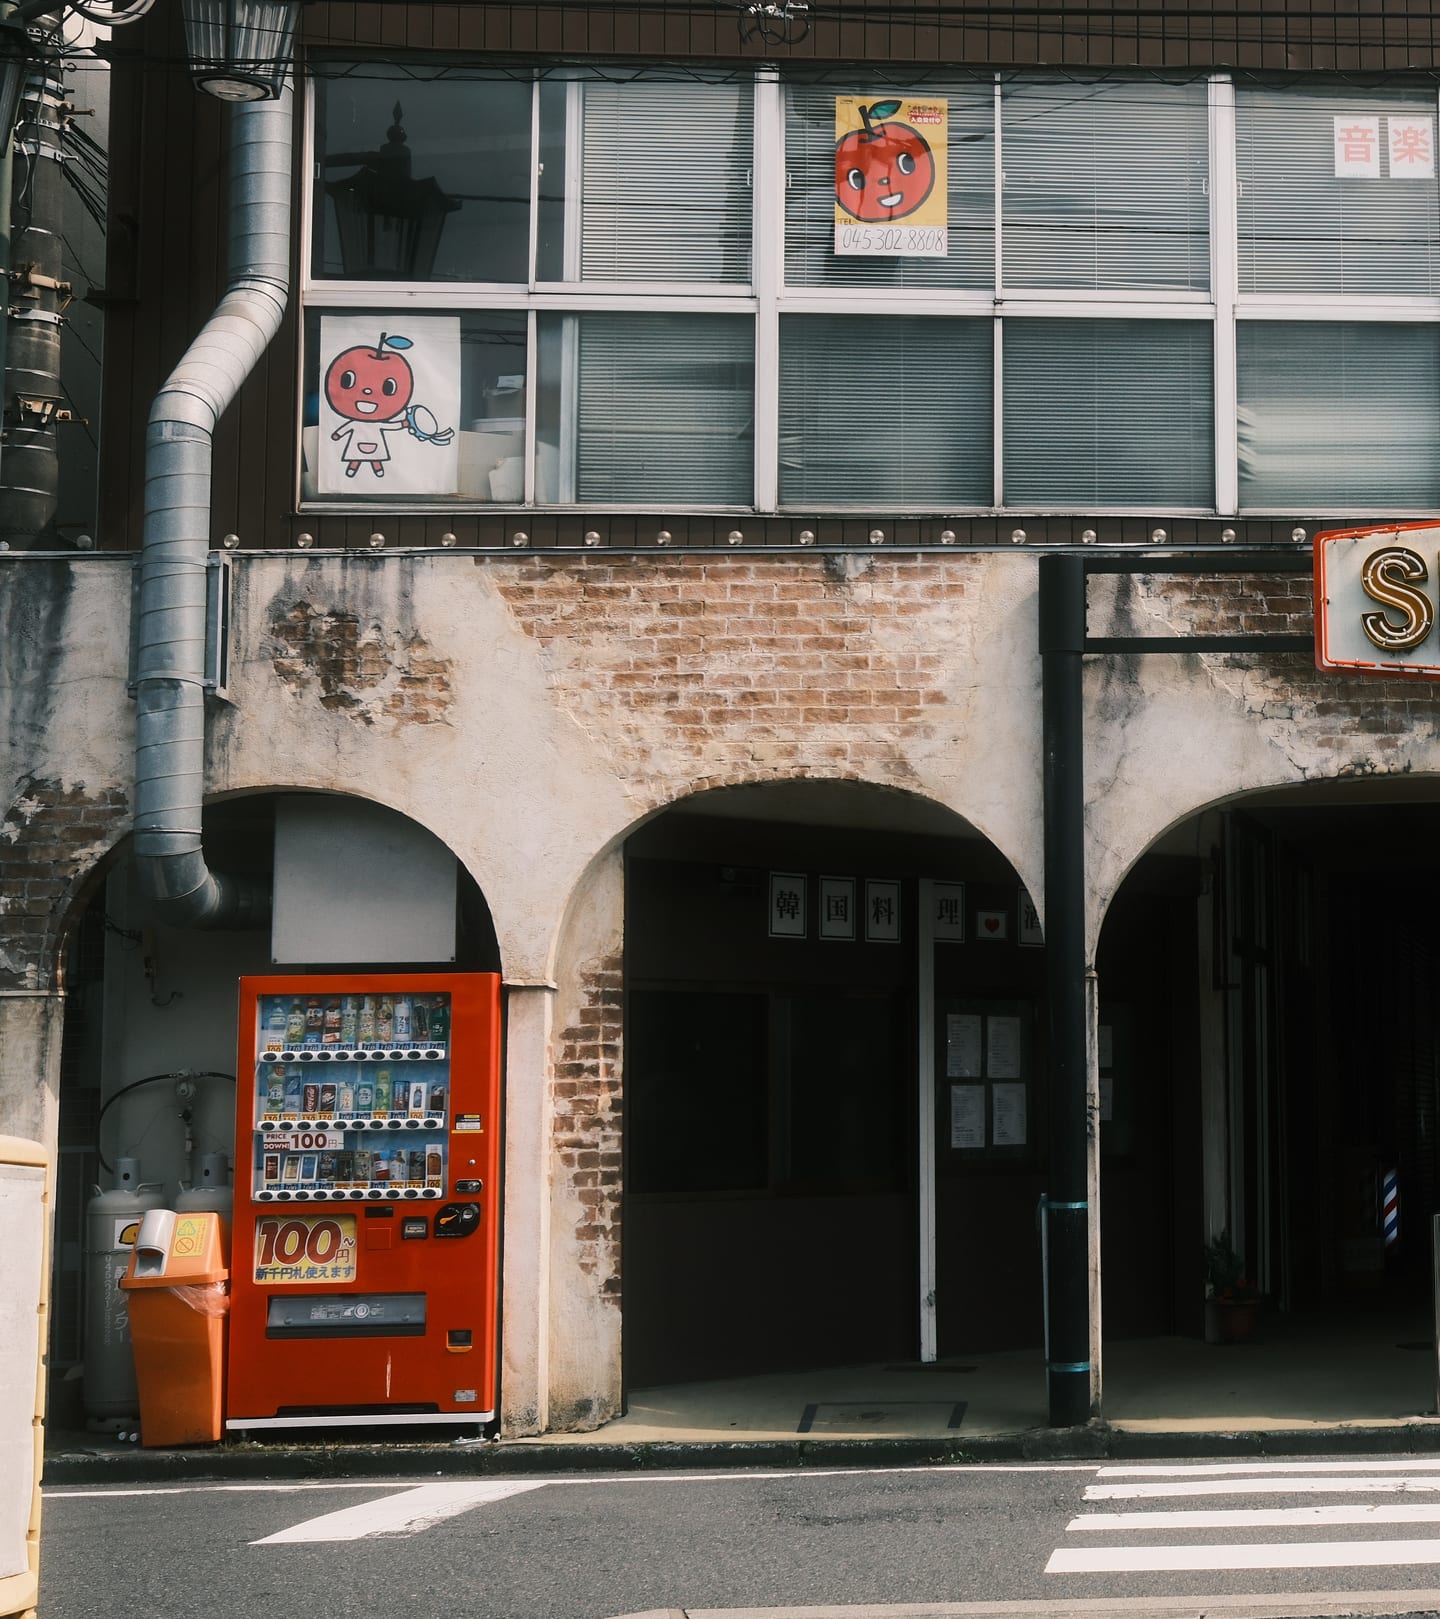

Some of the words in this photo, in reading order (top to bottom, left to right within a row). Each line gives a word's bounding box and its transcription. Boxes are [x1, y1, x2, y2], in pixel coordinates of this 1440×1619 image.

[266, 1132, 288, 1140] PRICE
[256, 1266, 355, 1280] 新千円札使えます
